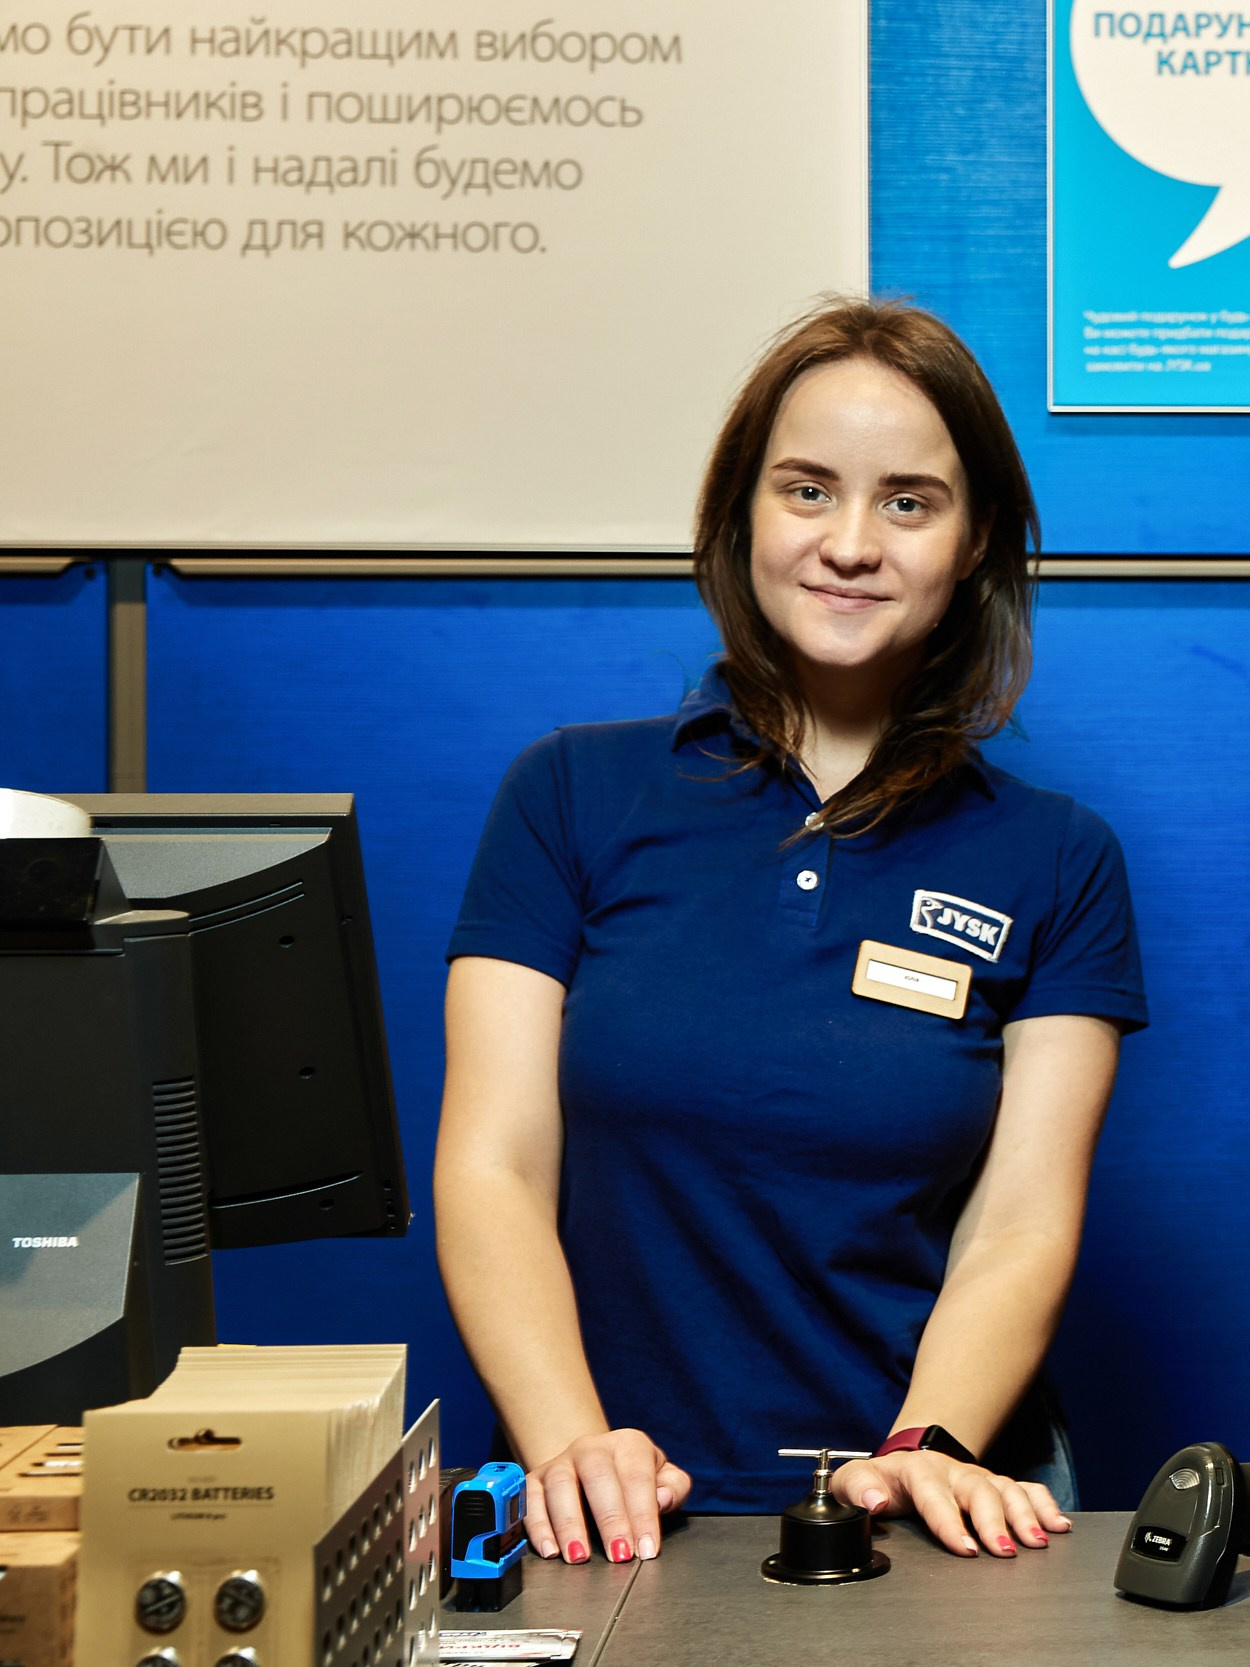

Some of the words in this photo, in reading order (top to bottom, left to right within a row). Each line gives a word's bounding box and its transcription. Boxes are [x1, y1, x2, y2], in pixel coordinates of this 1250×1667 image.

[66, 10, 172, 67] бути
[189, 16, 458, 69] найкращим
[475, 18, 683, 73] вибором
[0, 79, 265, 129] працівників
[279, 81, 289, 122] і
[306, 90, 644, 136] поширюємось
[41, 140, 132, 185] Тож
[147, 154, 209, 185] ми
[226, 145, 235, 185] і
[252, 146, 398, 194] надалі
[414, 143, 583, 200] будемо
[240, 218, 325, 258] для
[342, 219, 547, 254] кожного.
[937, 907, 1001, 946] JYSK
[12, 1236, 81, 1248] TOSHIBA
[128, 1488, 187, 1501] CR2032
[191, 1486, 275, 1500] BATTERIES
